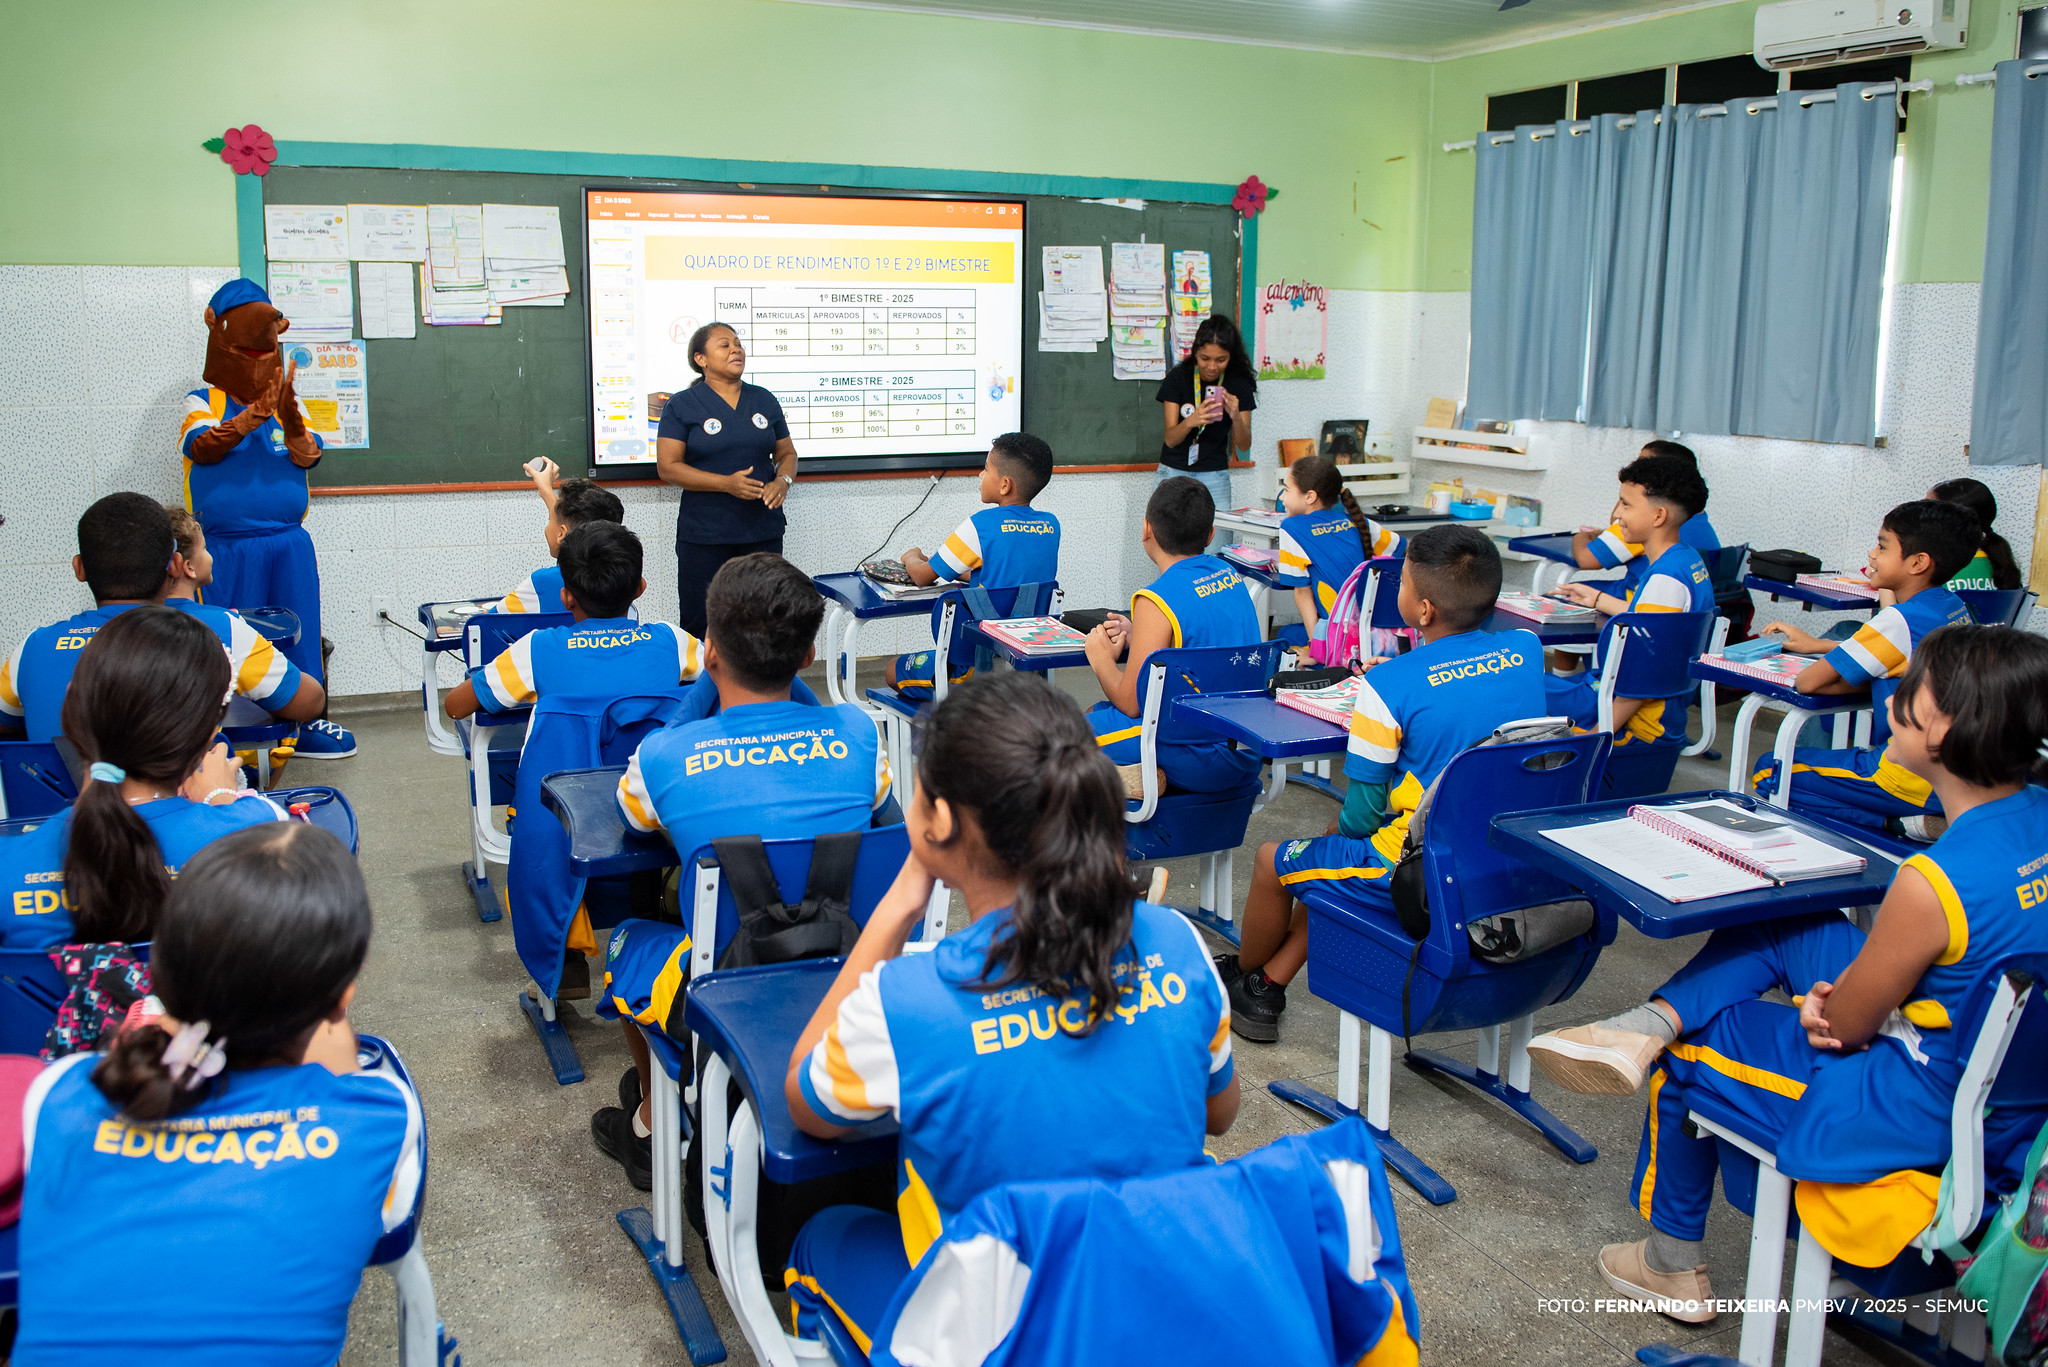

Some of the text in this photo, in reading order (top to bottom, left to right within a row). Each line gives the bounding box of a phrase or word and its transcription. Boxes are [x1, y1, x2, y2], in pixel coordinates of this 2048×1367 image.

[684, 254, 991, 272] QUADRO DE RENDIMENTO 1º E 2º BIMESTRE
[819, 294, 829, 303] 1º
[831, 294, 883, 303] BIMESTRE
[892, 294, 914, 303] 2025
[718, 302, 748, 310] TURMA
[756, 310, 806, 319] MATRÍCULAS
[813, 312, 860, 320] APROVADOS
[872, 312, 880, 320] %
[892, 312, 942, 320] REPROVADOS
[958, 312, 965, 320] %
[775, 328, 788, 336] 196
[831, 328, 844, 336] 193
[868, 328, 884, 336] 98%
[955, 328, 966, 336] 2%
[316, 345, 332, 353] DIA
[775, 344, 788, 352] 198
[831, 344, 844, 352] 193
[868, 344, 884, 352] 97%
[318, 354, 358, 368] SAEB
[819, 377, 830, 386] 2º
[832, 377, 883, 386] BIMESTRE
[892, 376, 914, 385] 2025
[778, 395, 806, 403] ÍCULAS
[814, 394, 860, 402] APROVADOS
[873, 394, 880, 402] %
[831, 410, 844, 418] 189
[955, 408, 966, 416] 4%
[831, 426, 844, 434] 195
[1001, 523, 1054, 535] EDUCAÇÃO
[1194, 572, 1242, 598] EDUCAÇÃO
[568, 631, 652, 650] EDUCAÇÃO
[1428, 659, 1468, 672] SECRETARIA
[1467, 650, 1501, 663] MUNICIPAL
[1427, 654, 1524, 687] EDUCAÇÃO
[694, 728, 835, 750] SECRETARIA MUNICIPAL DE
[685, 736, 848, 776] EDUCAÇÃO
[1146, 953, 1164, 968] DE
[208, 1110, 292, 1131] MUNICIPAL
[297, 1106, 320, 1122] DE
[93, 1119, 339, 1170] EDUCAÇÃO
